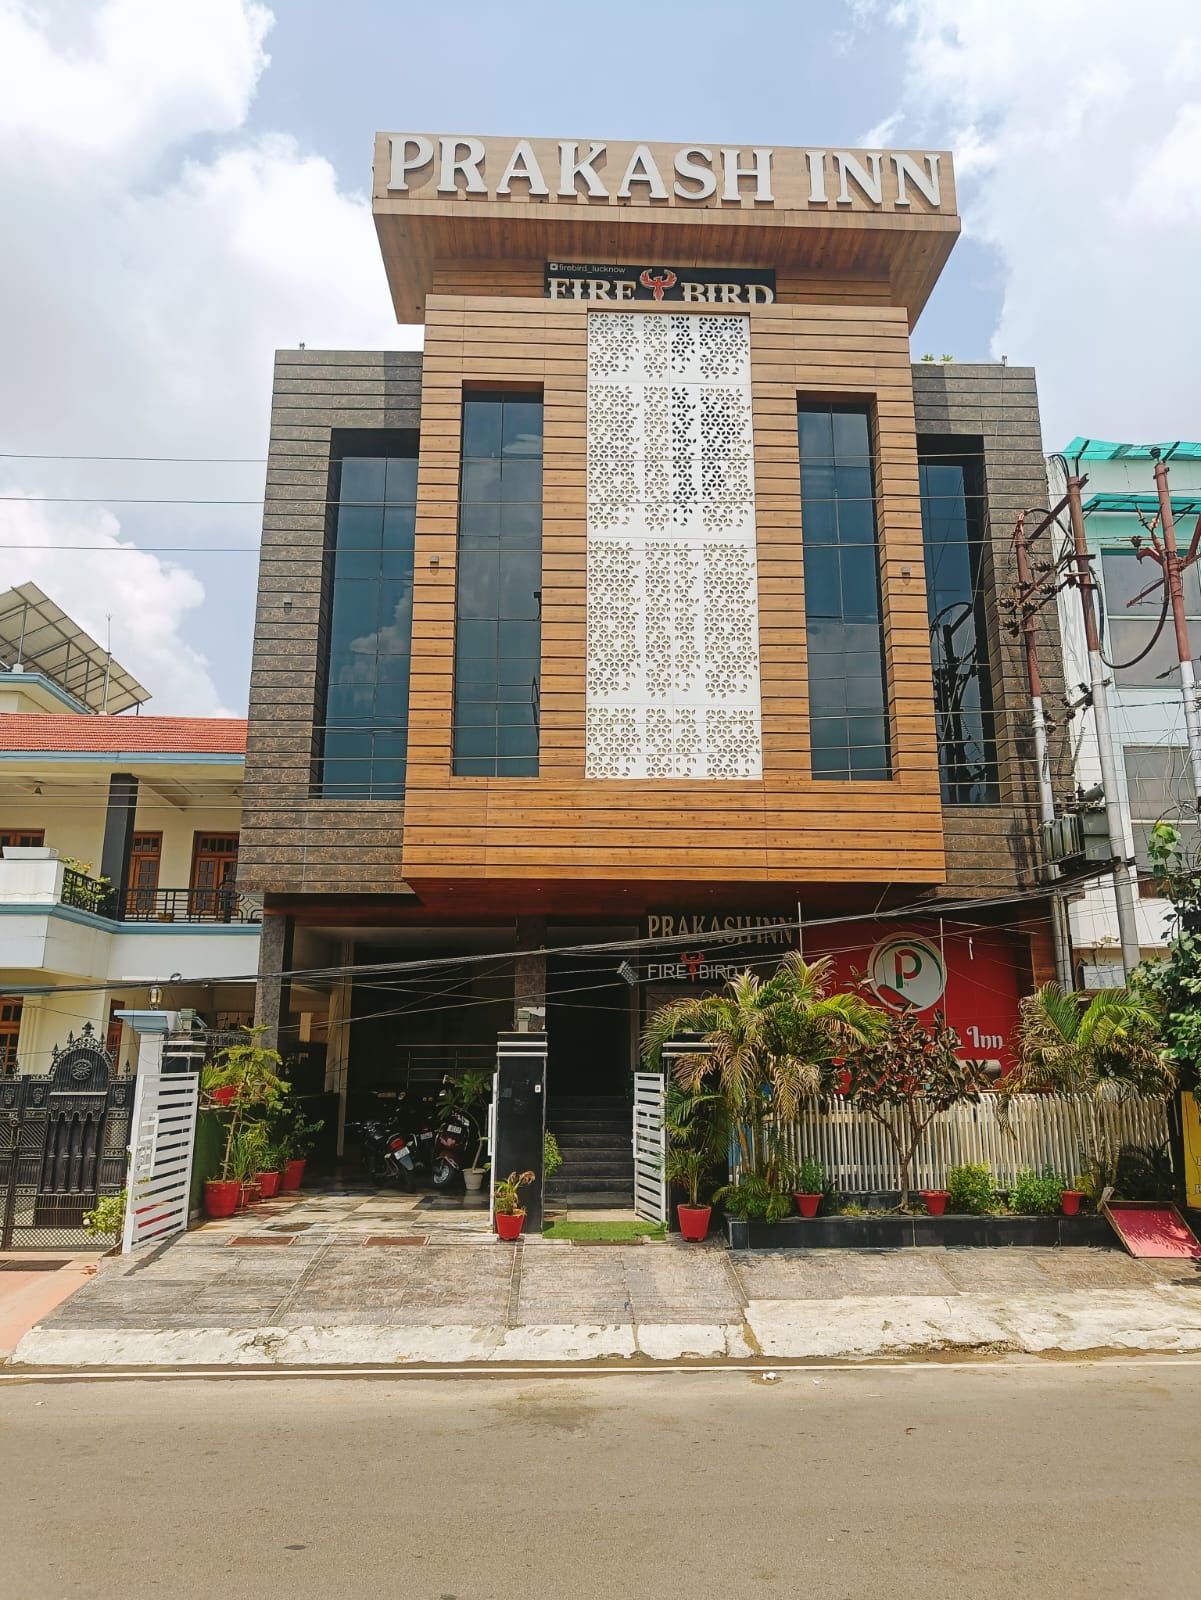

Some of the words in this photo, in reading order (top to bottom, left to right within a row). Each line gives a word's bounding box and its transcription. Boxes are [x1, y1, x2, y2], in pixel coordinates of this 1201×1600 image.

[387, 136, 774, 203] PRAKASH
[806, 150, 941, 207] INN
[558, 263, 626, 275] firebird_lucknow
[547, 277, 636, 301] FIRE
[681, 282, 775, 304] BIRD
[647, 963, 687, 980] FIRE
[699, 964, 738, 980] BIRD
[966, 1026, 1004, 1050] Inn
